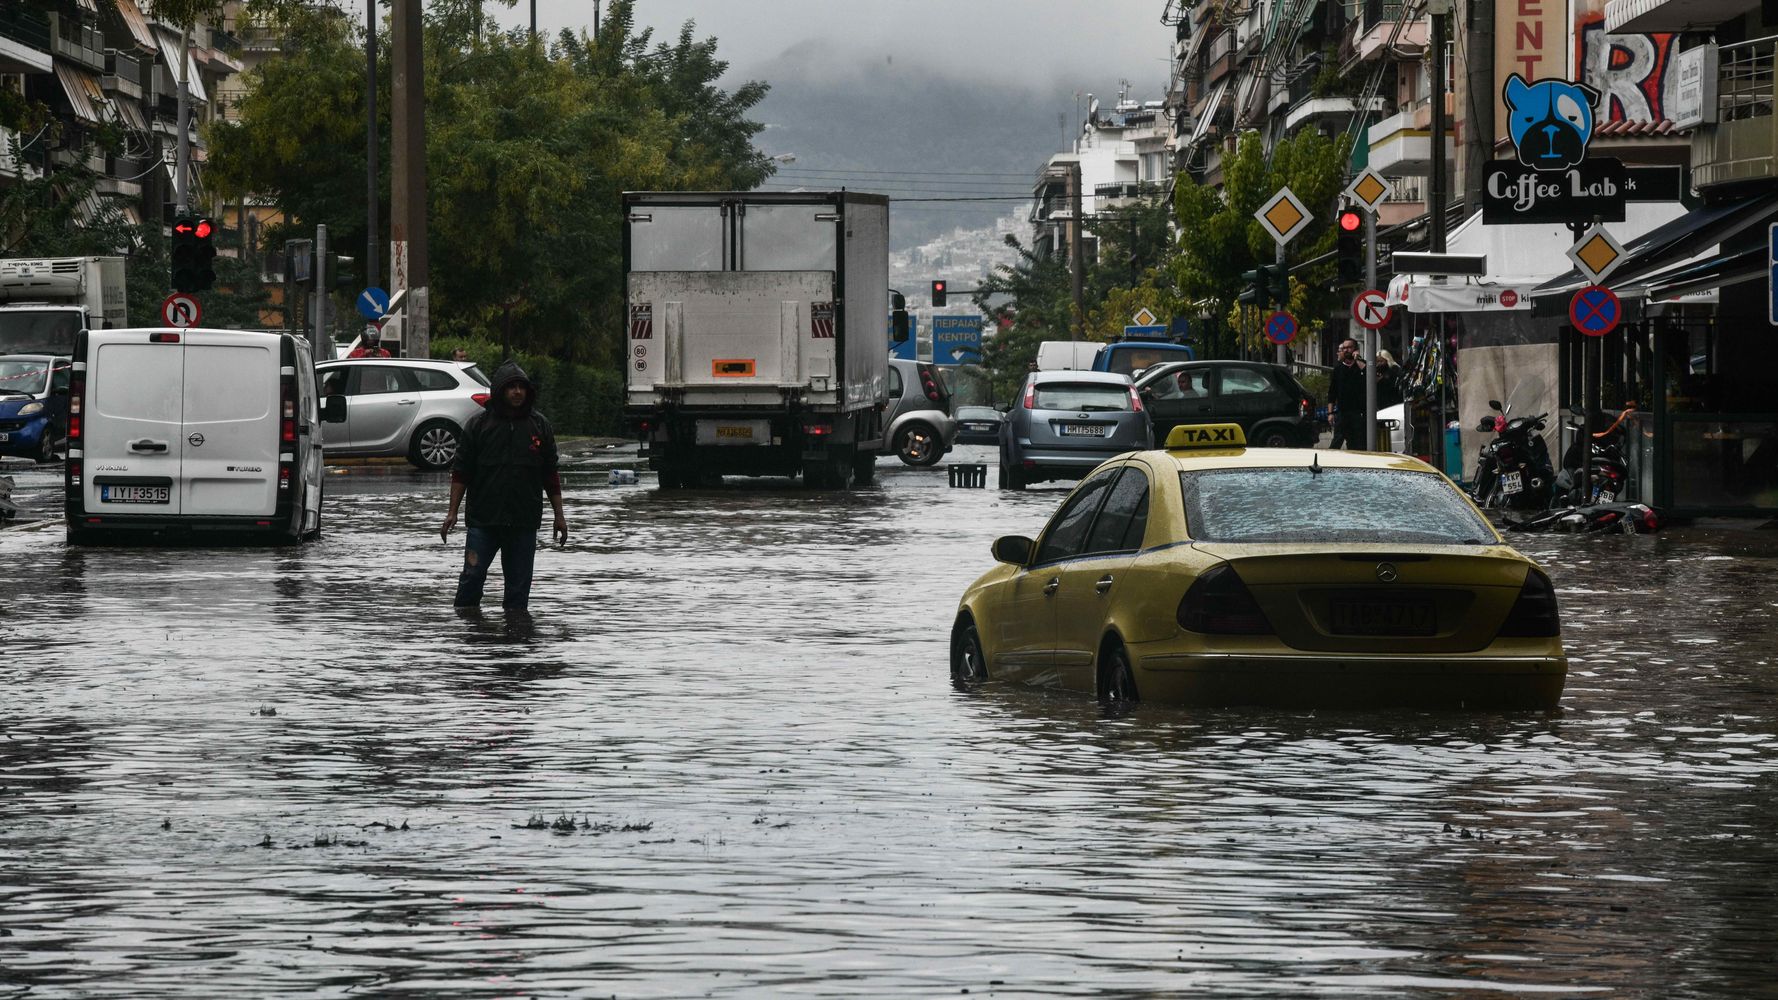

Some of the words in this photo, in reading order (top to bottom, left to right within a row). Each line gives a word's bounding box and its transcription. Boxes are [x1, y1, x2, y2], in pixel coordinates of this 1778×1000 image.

[1487, 171, 1561, 212] Coffee
[1566, 169, 1617, 197] Lab
[1477, 294, 1497, 304] mini
[935, 319, 980, 328] ΠΕΙΡΑΙΑΣ
[938, 332, 978, 342] ΚΕΝΤΡΟ
[1184, 428, 1235, 442] TAXI
